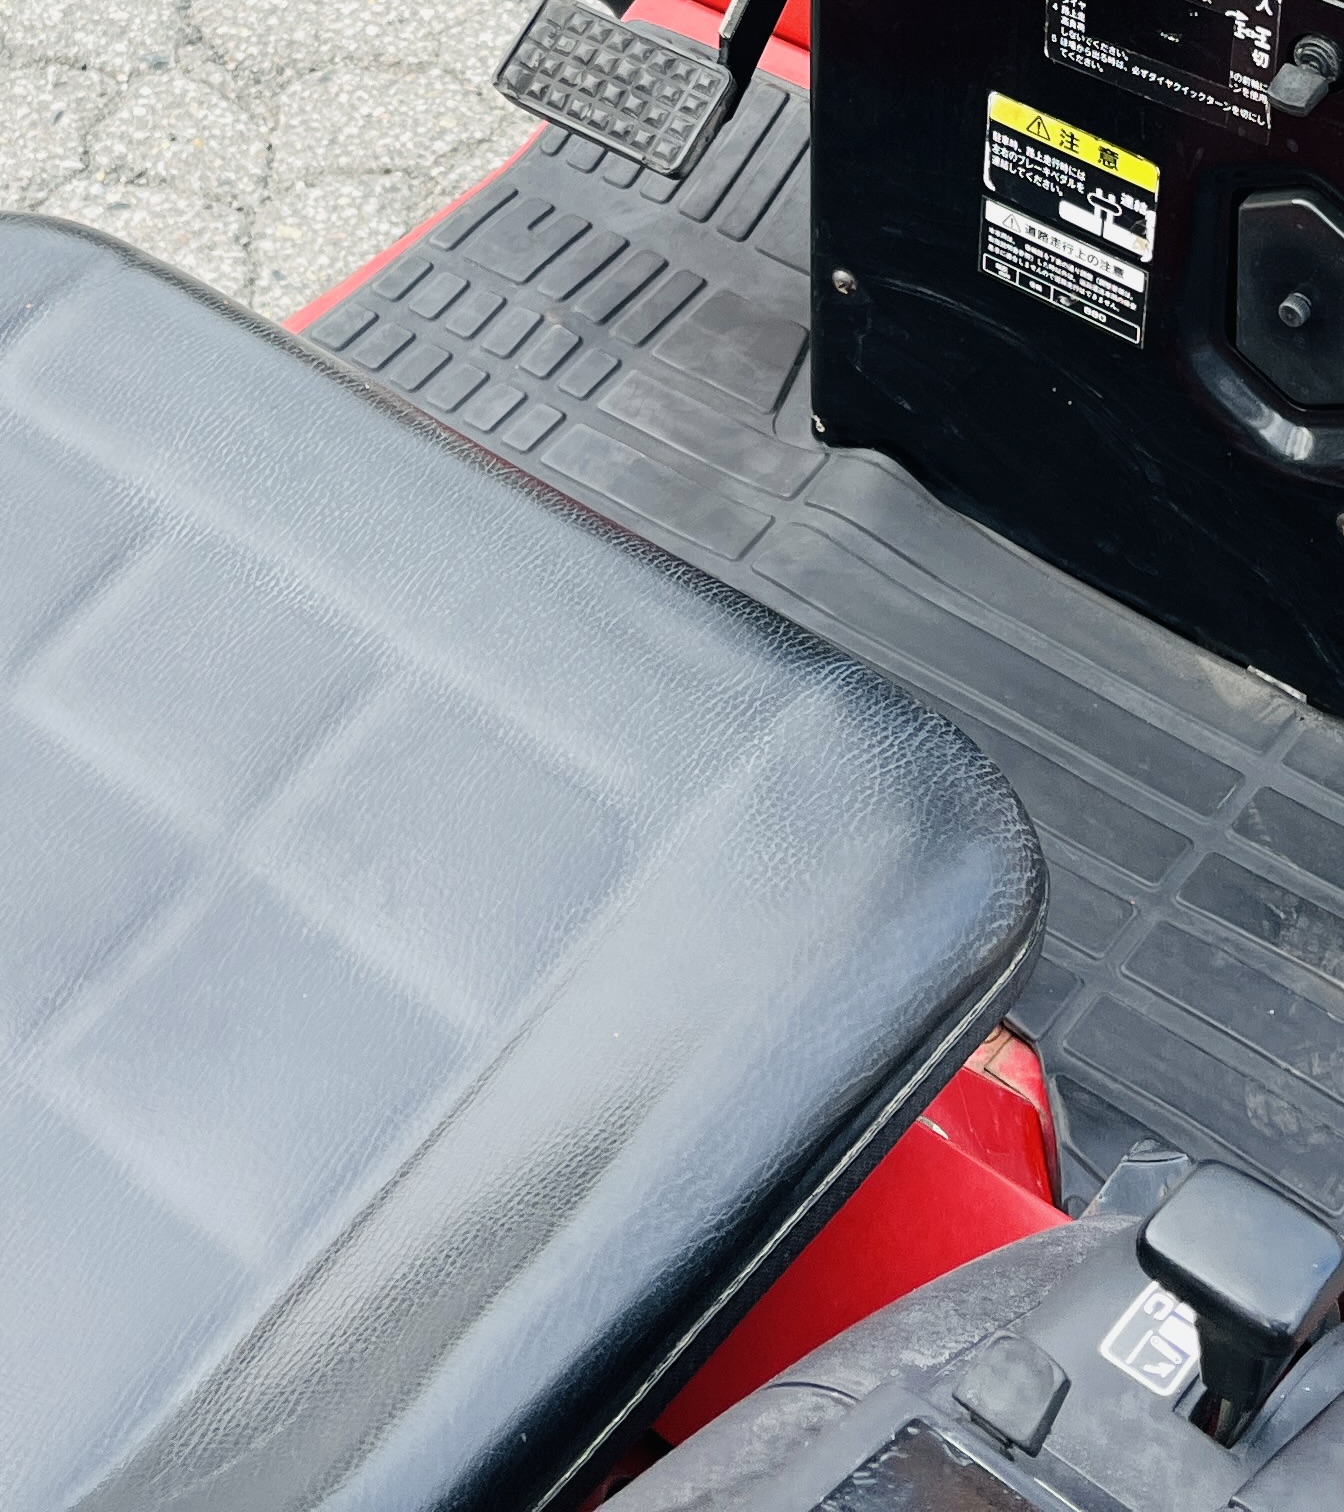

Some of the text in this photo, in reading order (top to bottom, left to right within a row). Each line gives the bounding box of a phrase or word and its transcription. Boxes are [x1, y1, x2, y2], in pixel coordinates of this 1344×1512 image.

[1251, 48, 1269, 69] 切
[1059, 128, 1119, 172] 注意
[1024, 223, 1126, 280] 道路走行上の注意
